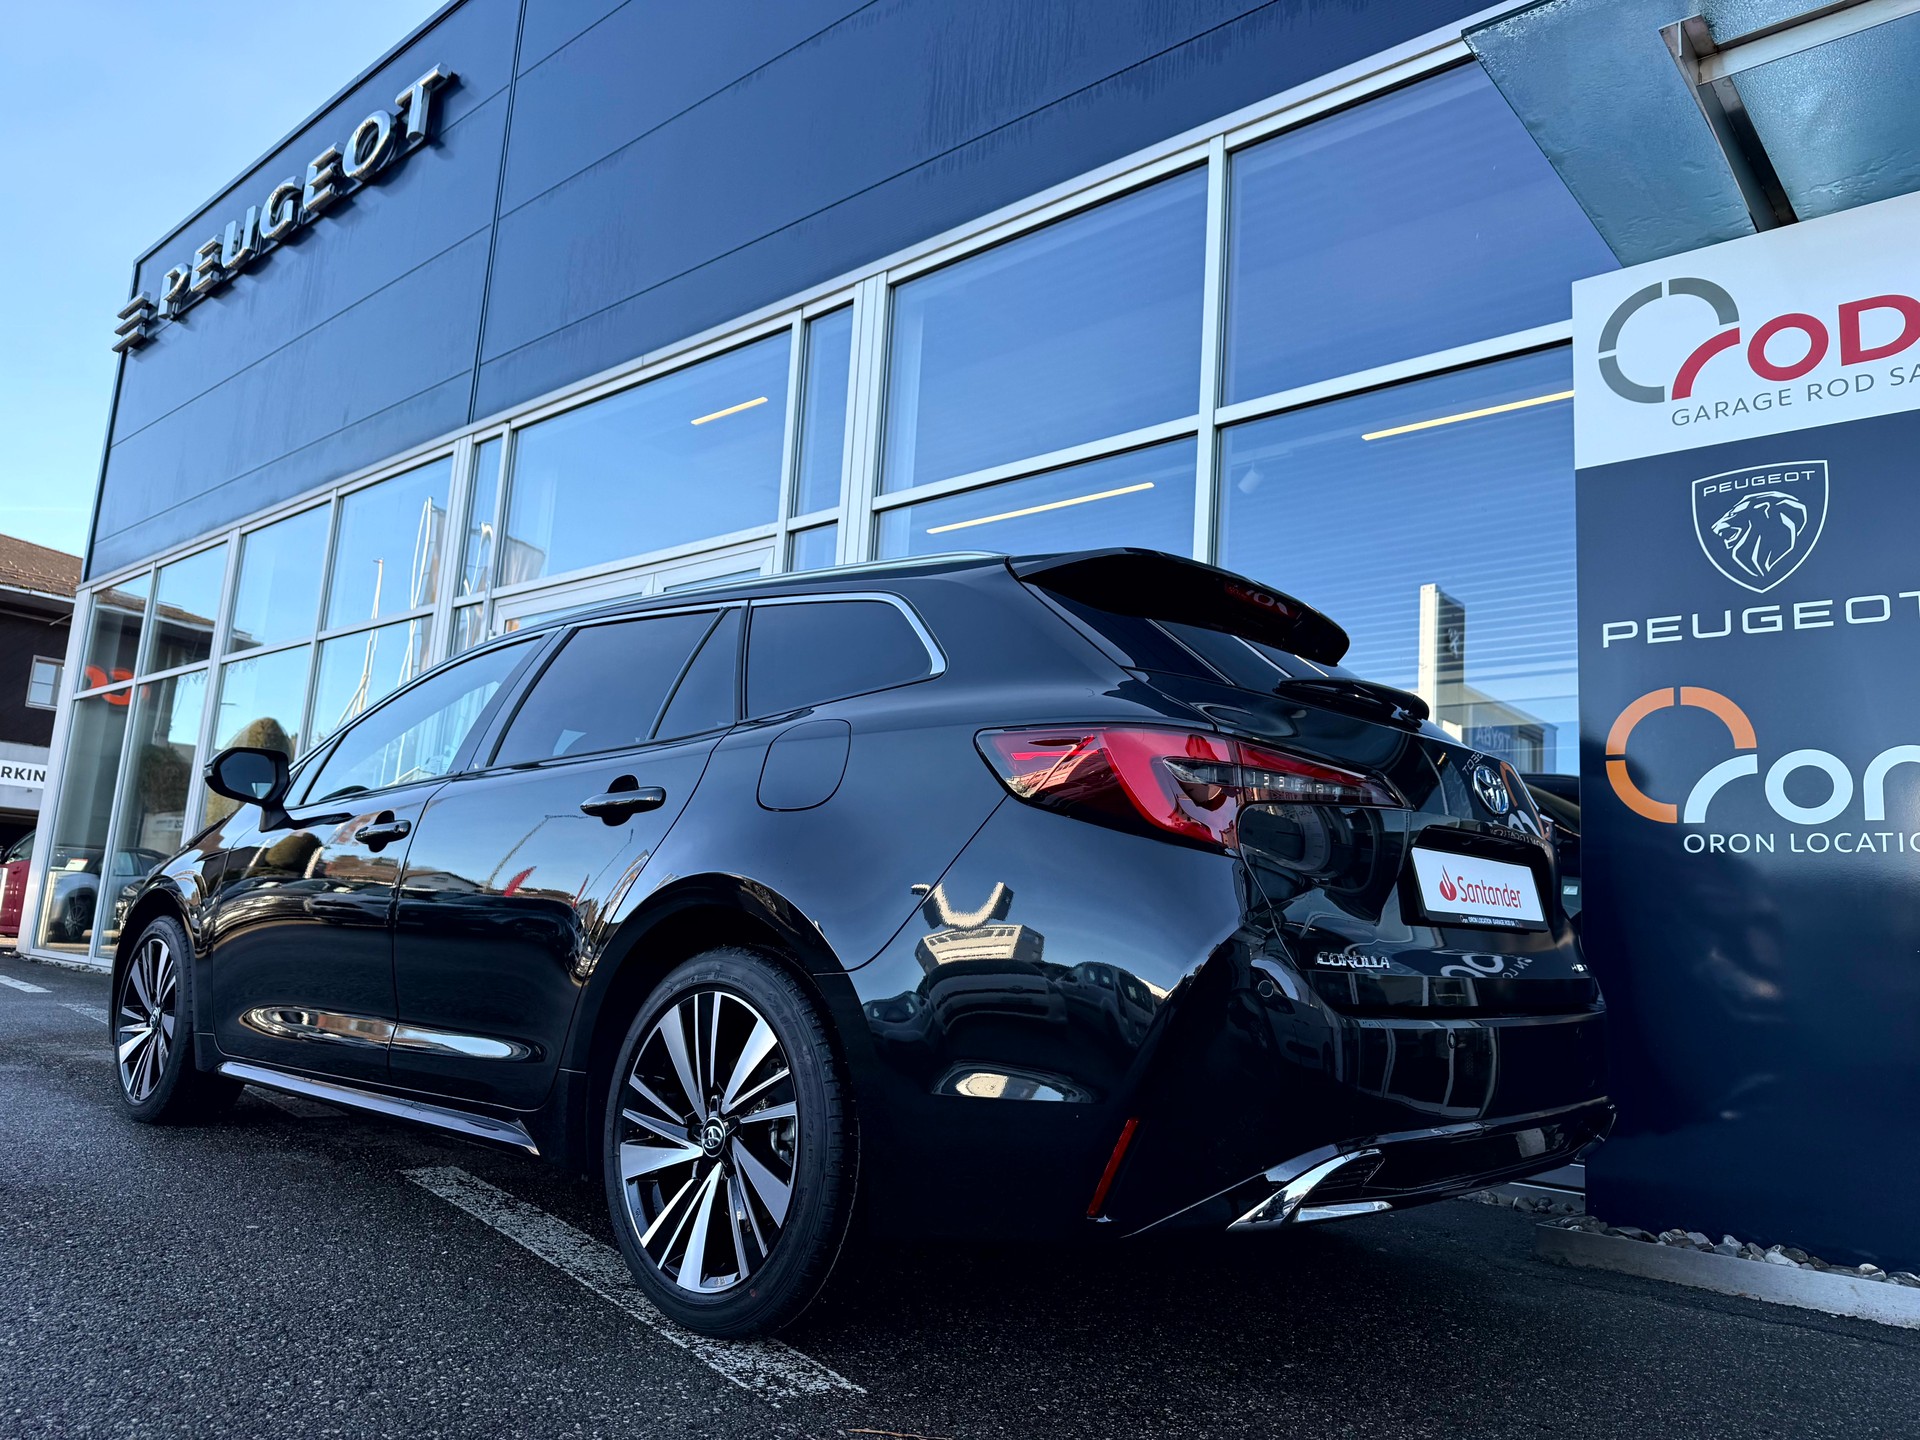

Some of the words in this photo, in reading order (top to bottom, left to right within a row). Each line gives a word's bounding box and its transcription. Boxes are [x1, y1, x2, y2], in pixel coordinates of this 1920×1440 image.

[158, 62, 453, 320] PEUGEOT
[1672, 388, 1792, 426] GARAGE
[1807, 373, 1875, 402] ROD
[1703, 470, 1816, 497] PEUGEOT
[1683, 833, 1775, 854] ORON
[1457, 876, 1521, 908] Santander
[1316, 951, 1390, 968] COROLLA
